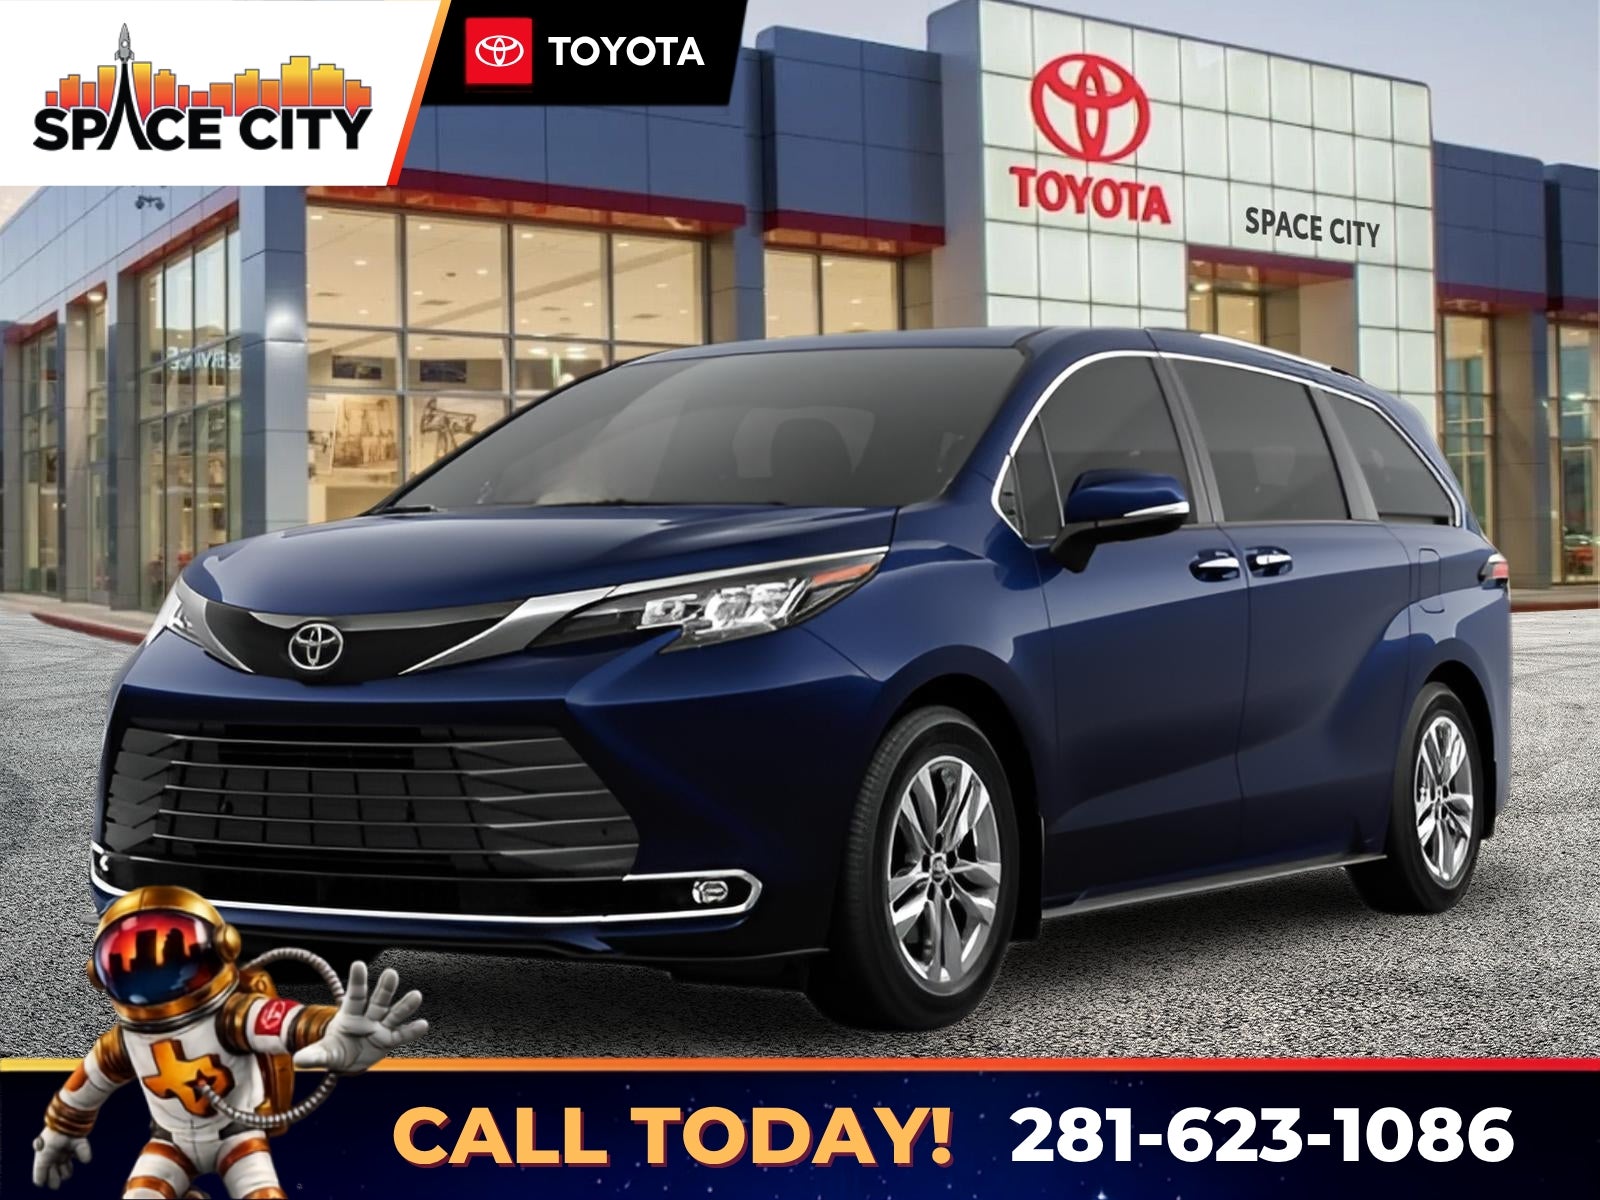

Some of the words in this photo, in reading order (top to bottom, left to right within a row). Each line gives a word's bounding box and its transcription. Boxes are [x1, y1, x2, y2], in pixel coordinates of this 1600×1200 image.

[1009, 166, 1171, 225] TOYOTA
[1245, 206, 1322, 242] SPACE
[1329, 218, 1380, 248] CITY
